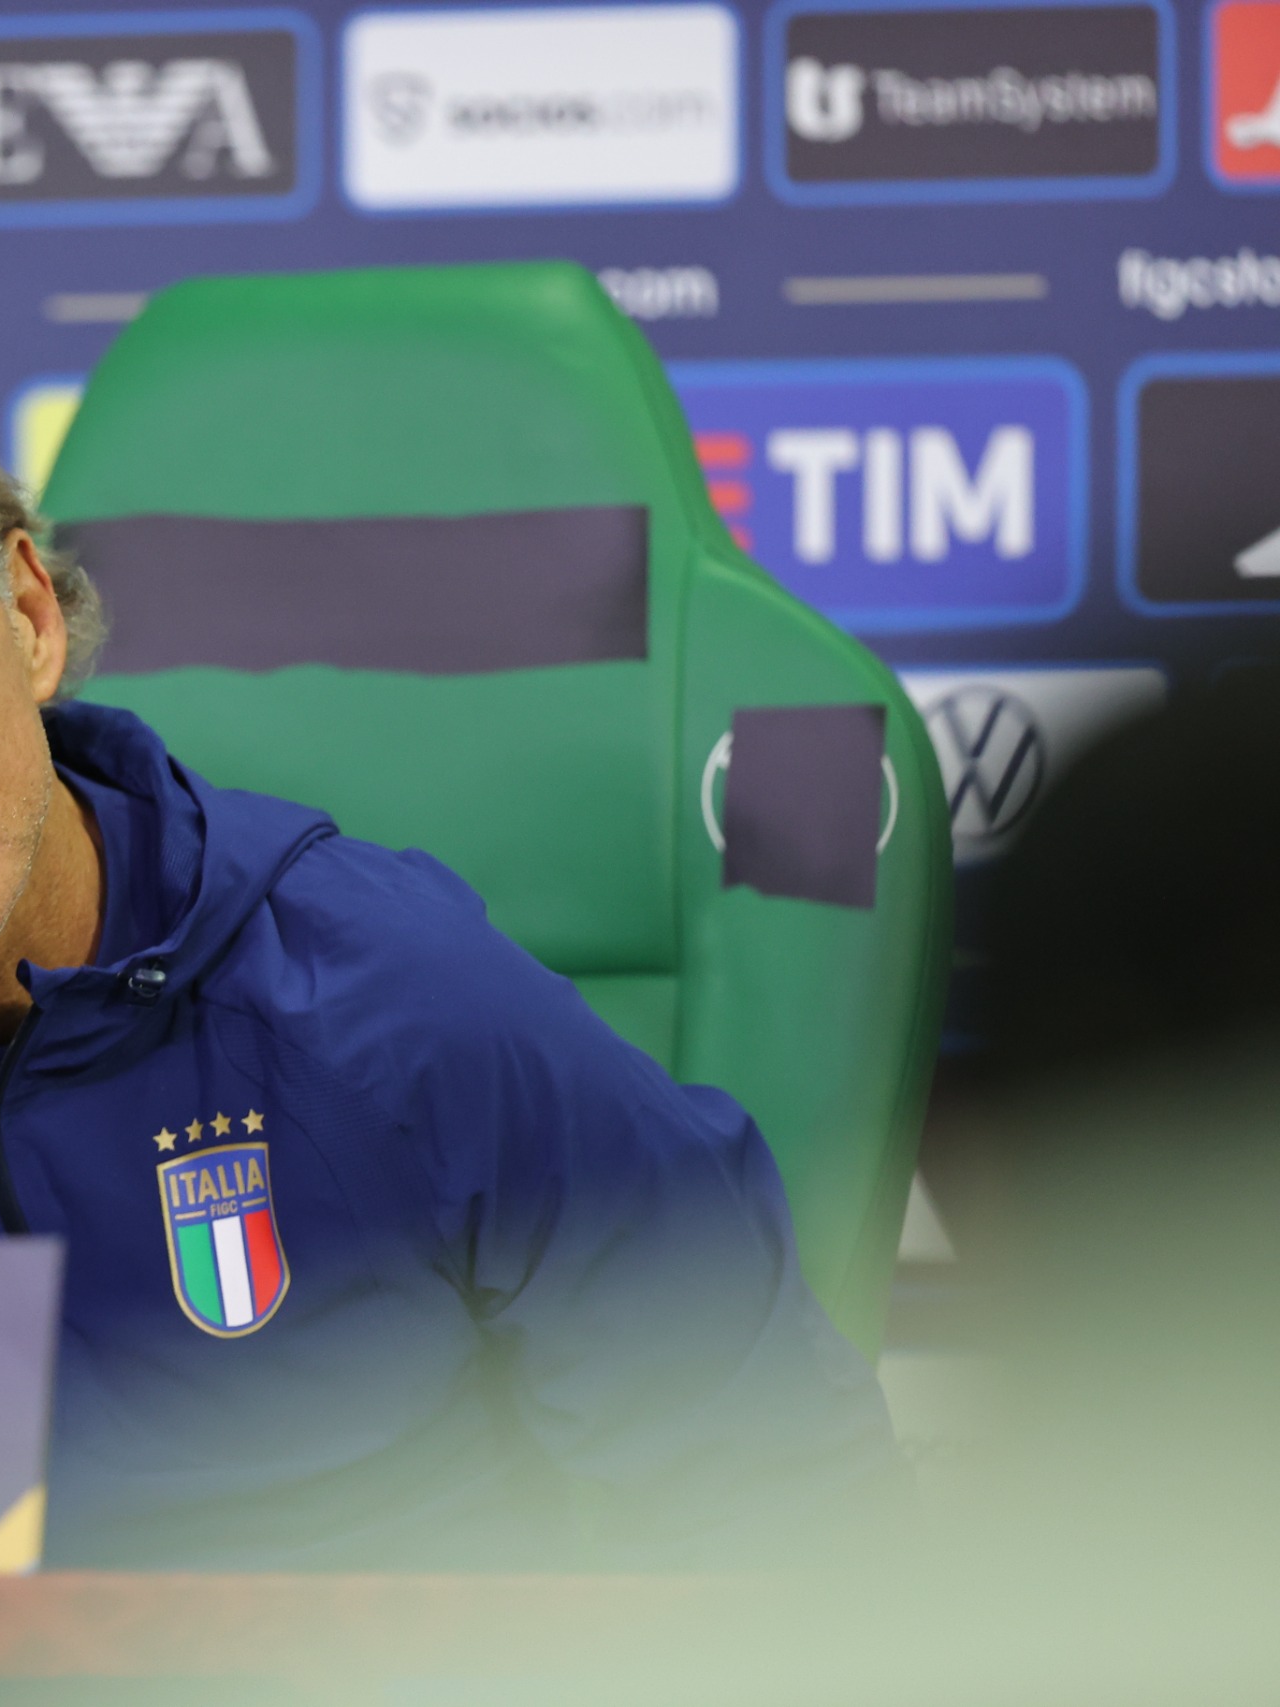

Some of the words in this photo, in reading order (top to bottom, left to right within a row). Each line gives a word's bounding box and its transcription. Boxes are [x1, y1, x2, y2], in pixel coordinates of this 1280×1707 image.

[876, 67, 1156, 132] TeamSystem
[767, 425, 1037, 564] TIM
[168, 1157, 265, 1208] ITALIA
[210, 1200, 239, 1218] FIGC
